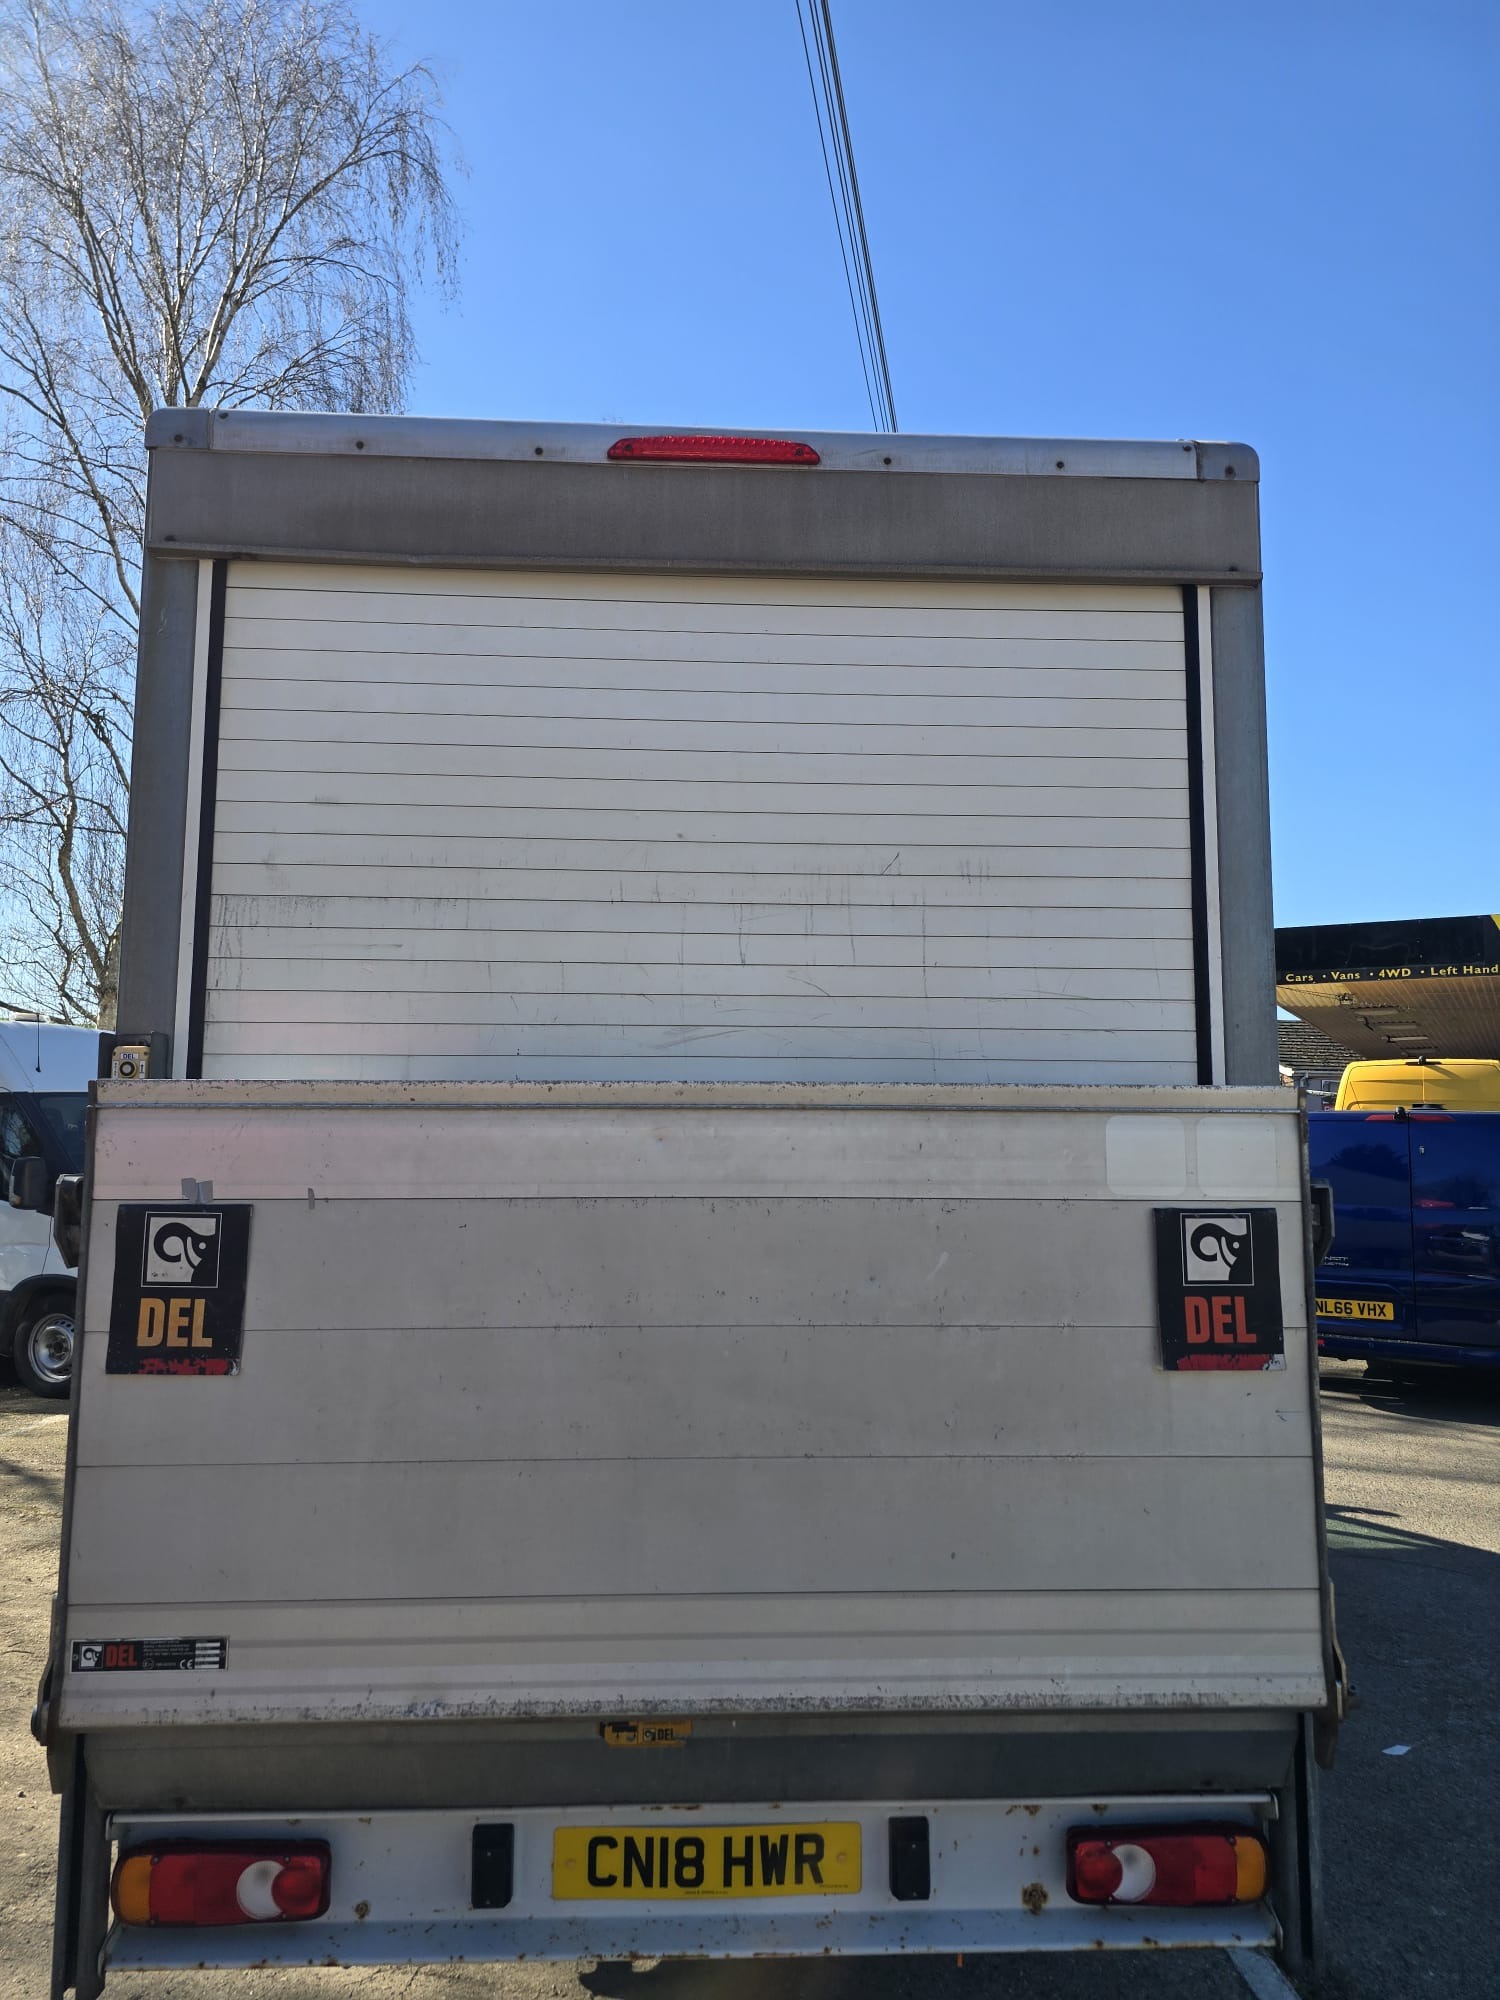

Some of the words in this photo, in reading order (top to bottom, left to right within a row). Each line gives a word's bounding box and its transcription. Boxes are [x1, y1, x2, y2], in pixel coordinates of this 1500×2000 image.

[1285, 973, 1314, 982] Cars
[1330, 971, 1361, 980] Vans
[1378, 968, 1412, 978] 4WD
[1430, 966, 1458, 976] Left
[1463, 964, 1499, 974] Hand
[1184, 1296, 1257, 1343] DEL
[1315, 1301, 1353, 1315] NL66
[1357, 1303, 1387, 1317] VHX
[136, 1298, 213, 1347] DEL
[105, 1645, 137, 1667] DEL
[658, 1728, 675, 1741] DEL
[587, 1835, 705, 1888] CN18
[722, 1833, 825, 1888] HWR
